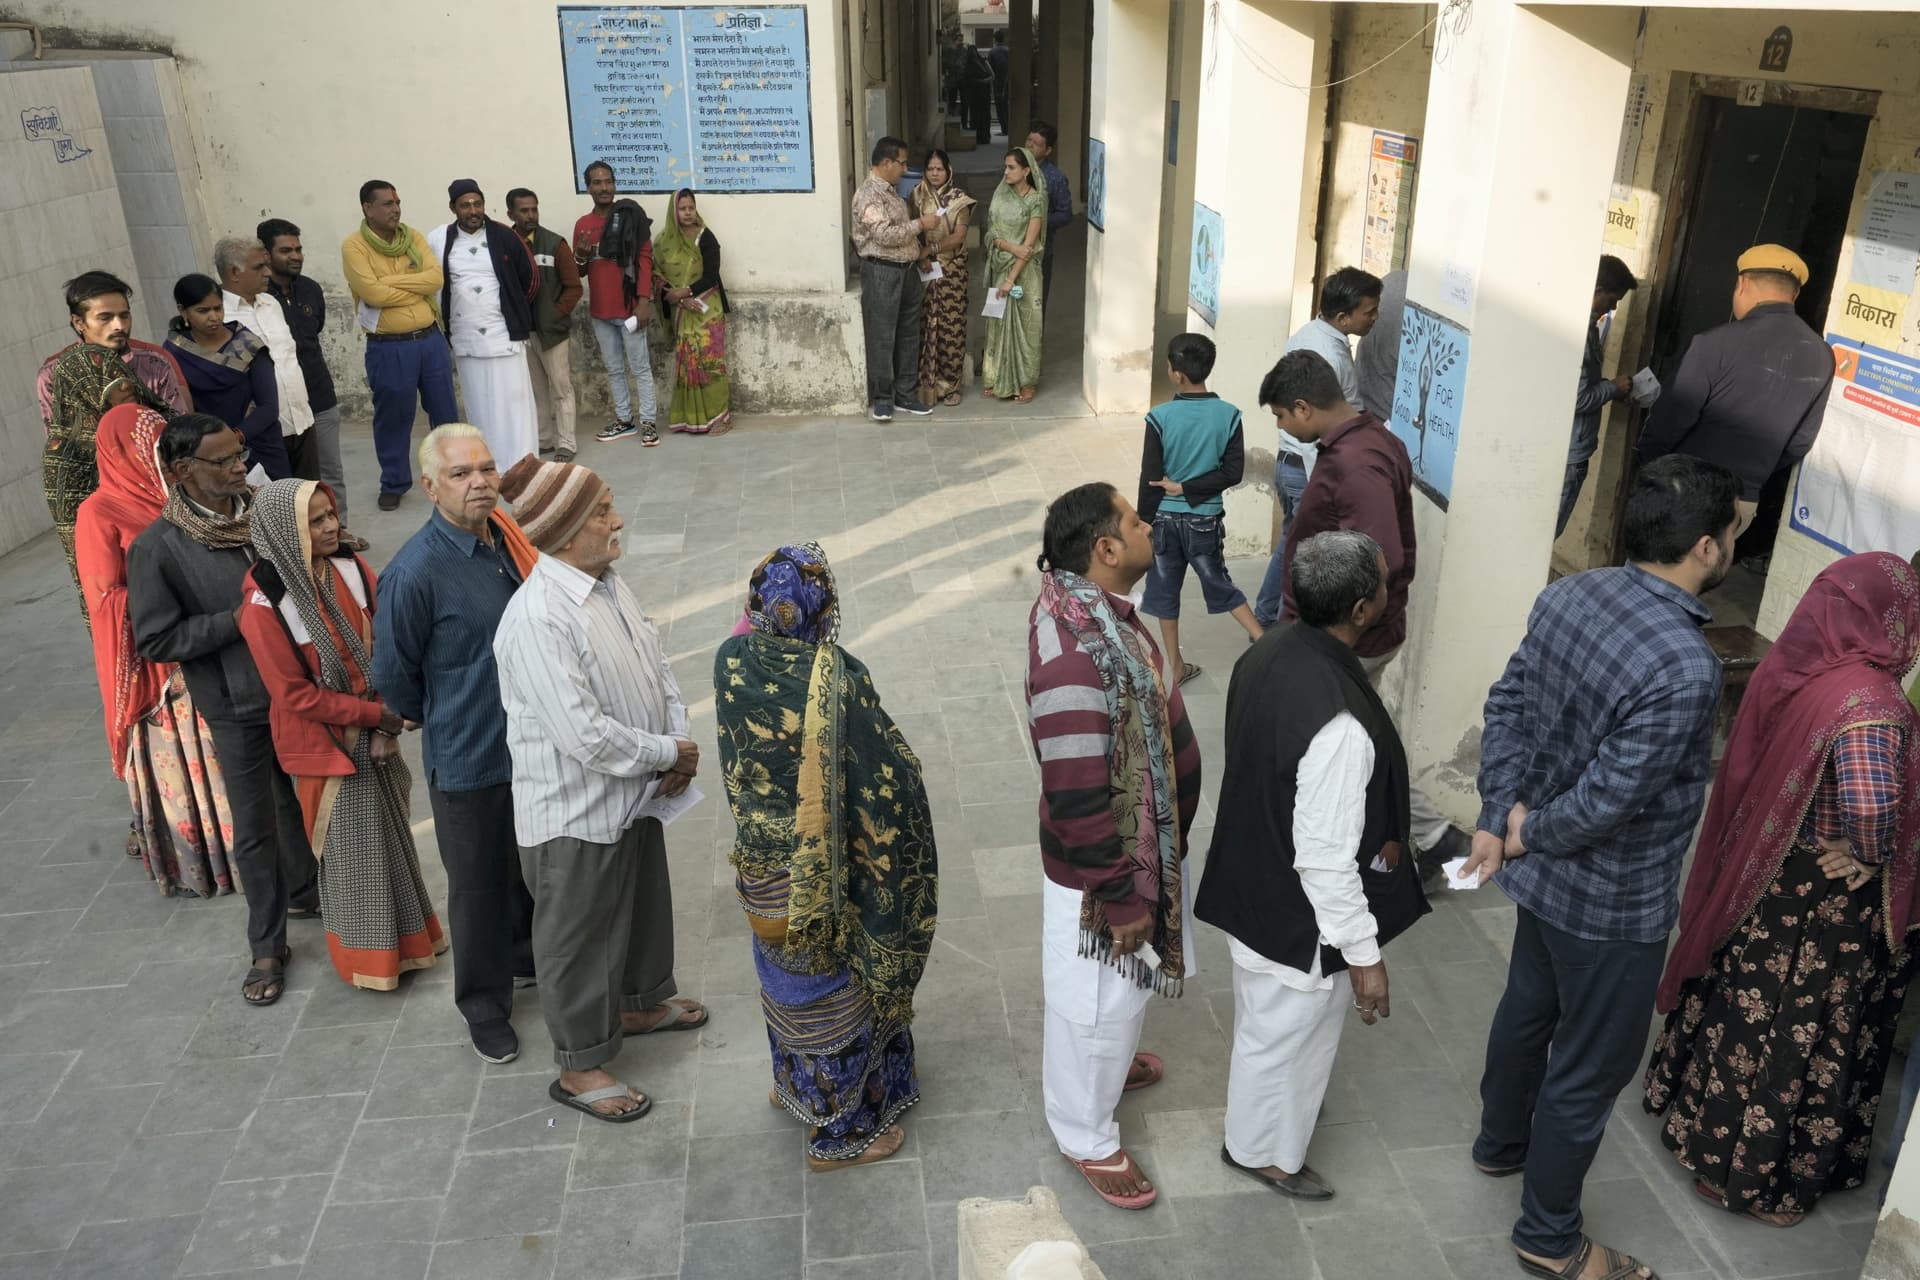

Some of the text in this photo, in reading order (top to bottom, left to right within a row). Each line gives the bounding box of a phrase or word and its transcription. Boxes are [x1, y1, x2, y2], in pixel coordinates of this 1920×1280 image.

[726, 13, 762, 31] प्रतिज्ञा
[1767, 43, 1785, 66] 12
[1745, 84, 1757, 102] 12
[1607, 207, 1636, 230] प्रवेश
[1846, 292, 1897, 329] निकास
[1402, 379, 1413, 399] IS
[1434, 383, 1454, 409] FOR
[1394, 396, 1411, 424] GOOD
[1427, 411, 1456, 444] HEALTH
